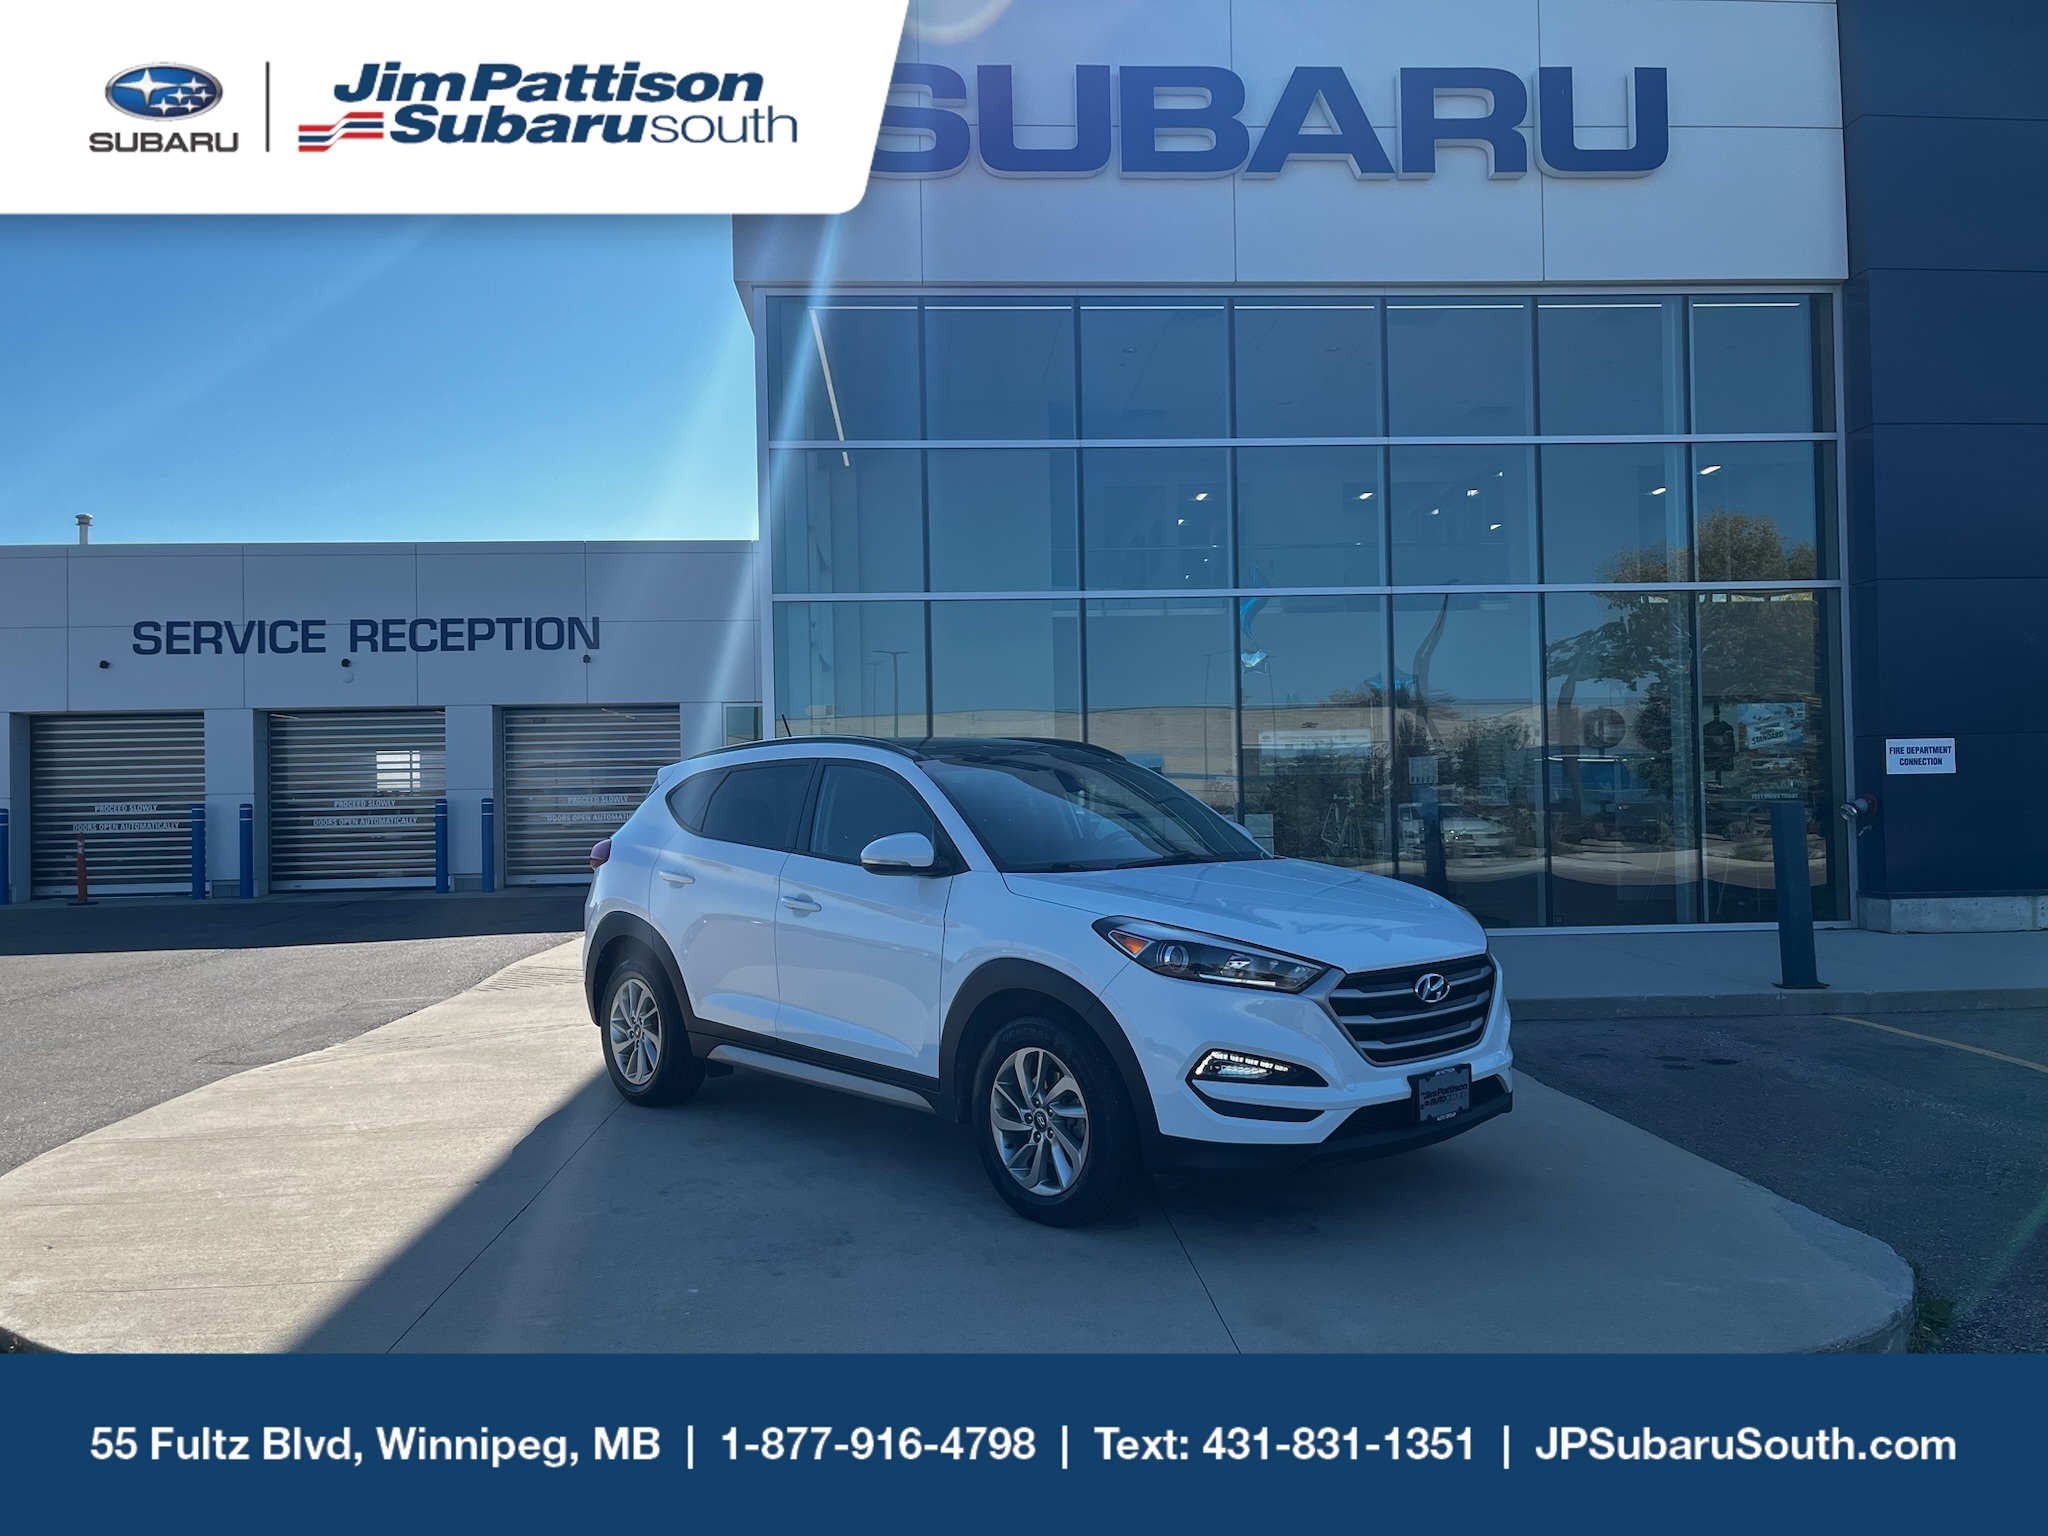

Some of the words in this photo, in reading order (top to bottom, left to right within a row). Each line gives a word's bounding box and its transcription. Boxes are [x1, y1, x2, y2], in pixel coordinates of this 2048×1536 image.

[869, 62, 1670, 178] SUBARU
[132, 619, 327, 656] SERVICE
[350, 616, 601, 653] RECEPTION
[1752, 731, 1784, 745] STANDARD
[1889, 746, 1905, 755] FIRE
[1906, 745, 1952, 755] DEPARTMENT
[1899, 757, 1943, 766] CONNECTION
[334, 800, 367, 808] PROCEED
[367, 799, 396, 807] SLOWLY
[567, 796, 599, 804] PROCEED
[600, 795, 629, 803] SLOWLY
[94, 804, 128, 813] PROCEED
[129, 804, 158, 812] SLOWLY
[312, 818, 337, 827] DOORS
[338, 818, 358, 826] OPEN
[359, 816, 418, 826] AUTOMATICALLY
[571, 814, 591, 822] OPEN
[72, 823, 97, 832] DOORS
[98, 822, 119, 831] OPEN
[120, 822, 180, 831] AUTOMATICALLY
[1437, 1084, 1467, 1096] Pattison
